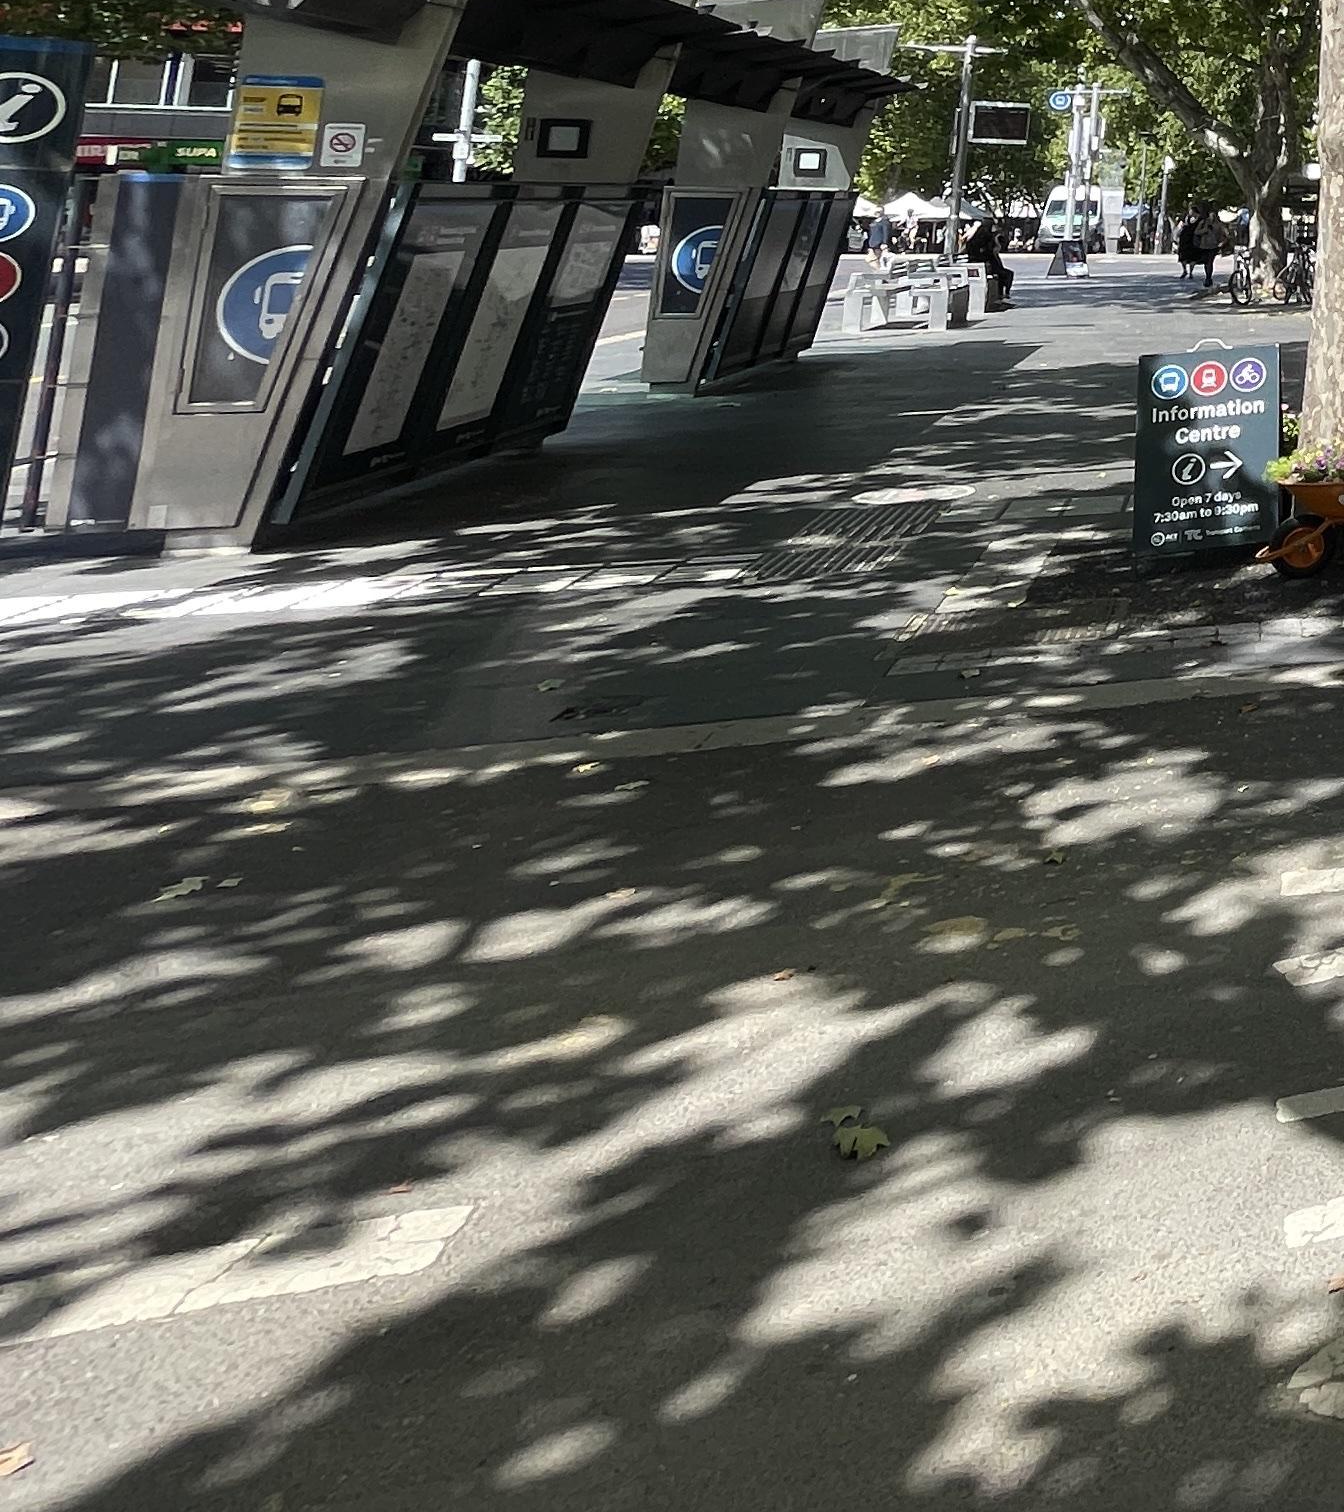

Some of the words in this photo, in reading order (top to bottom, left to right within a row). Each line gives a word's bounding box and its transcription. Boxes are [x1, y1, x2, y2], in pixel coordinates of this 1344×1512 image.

[1152, 398, 1265, 424] Information
[1174, 423, 1241, 445] Centre
[1171, 495, 1203, 509] Open
[1204, 493, 1213, 504] 7
[1213, 491, 1242, 504] days
[1153, 510, 1198, 524] 7:30am
[1199, 507, 1213, 518] to
